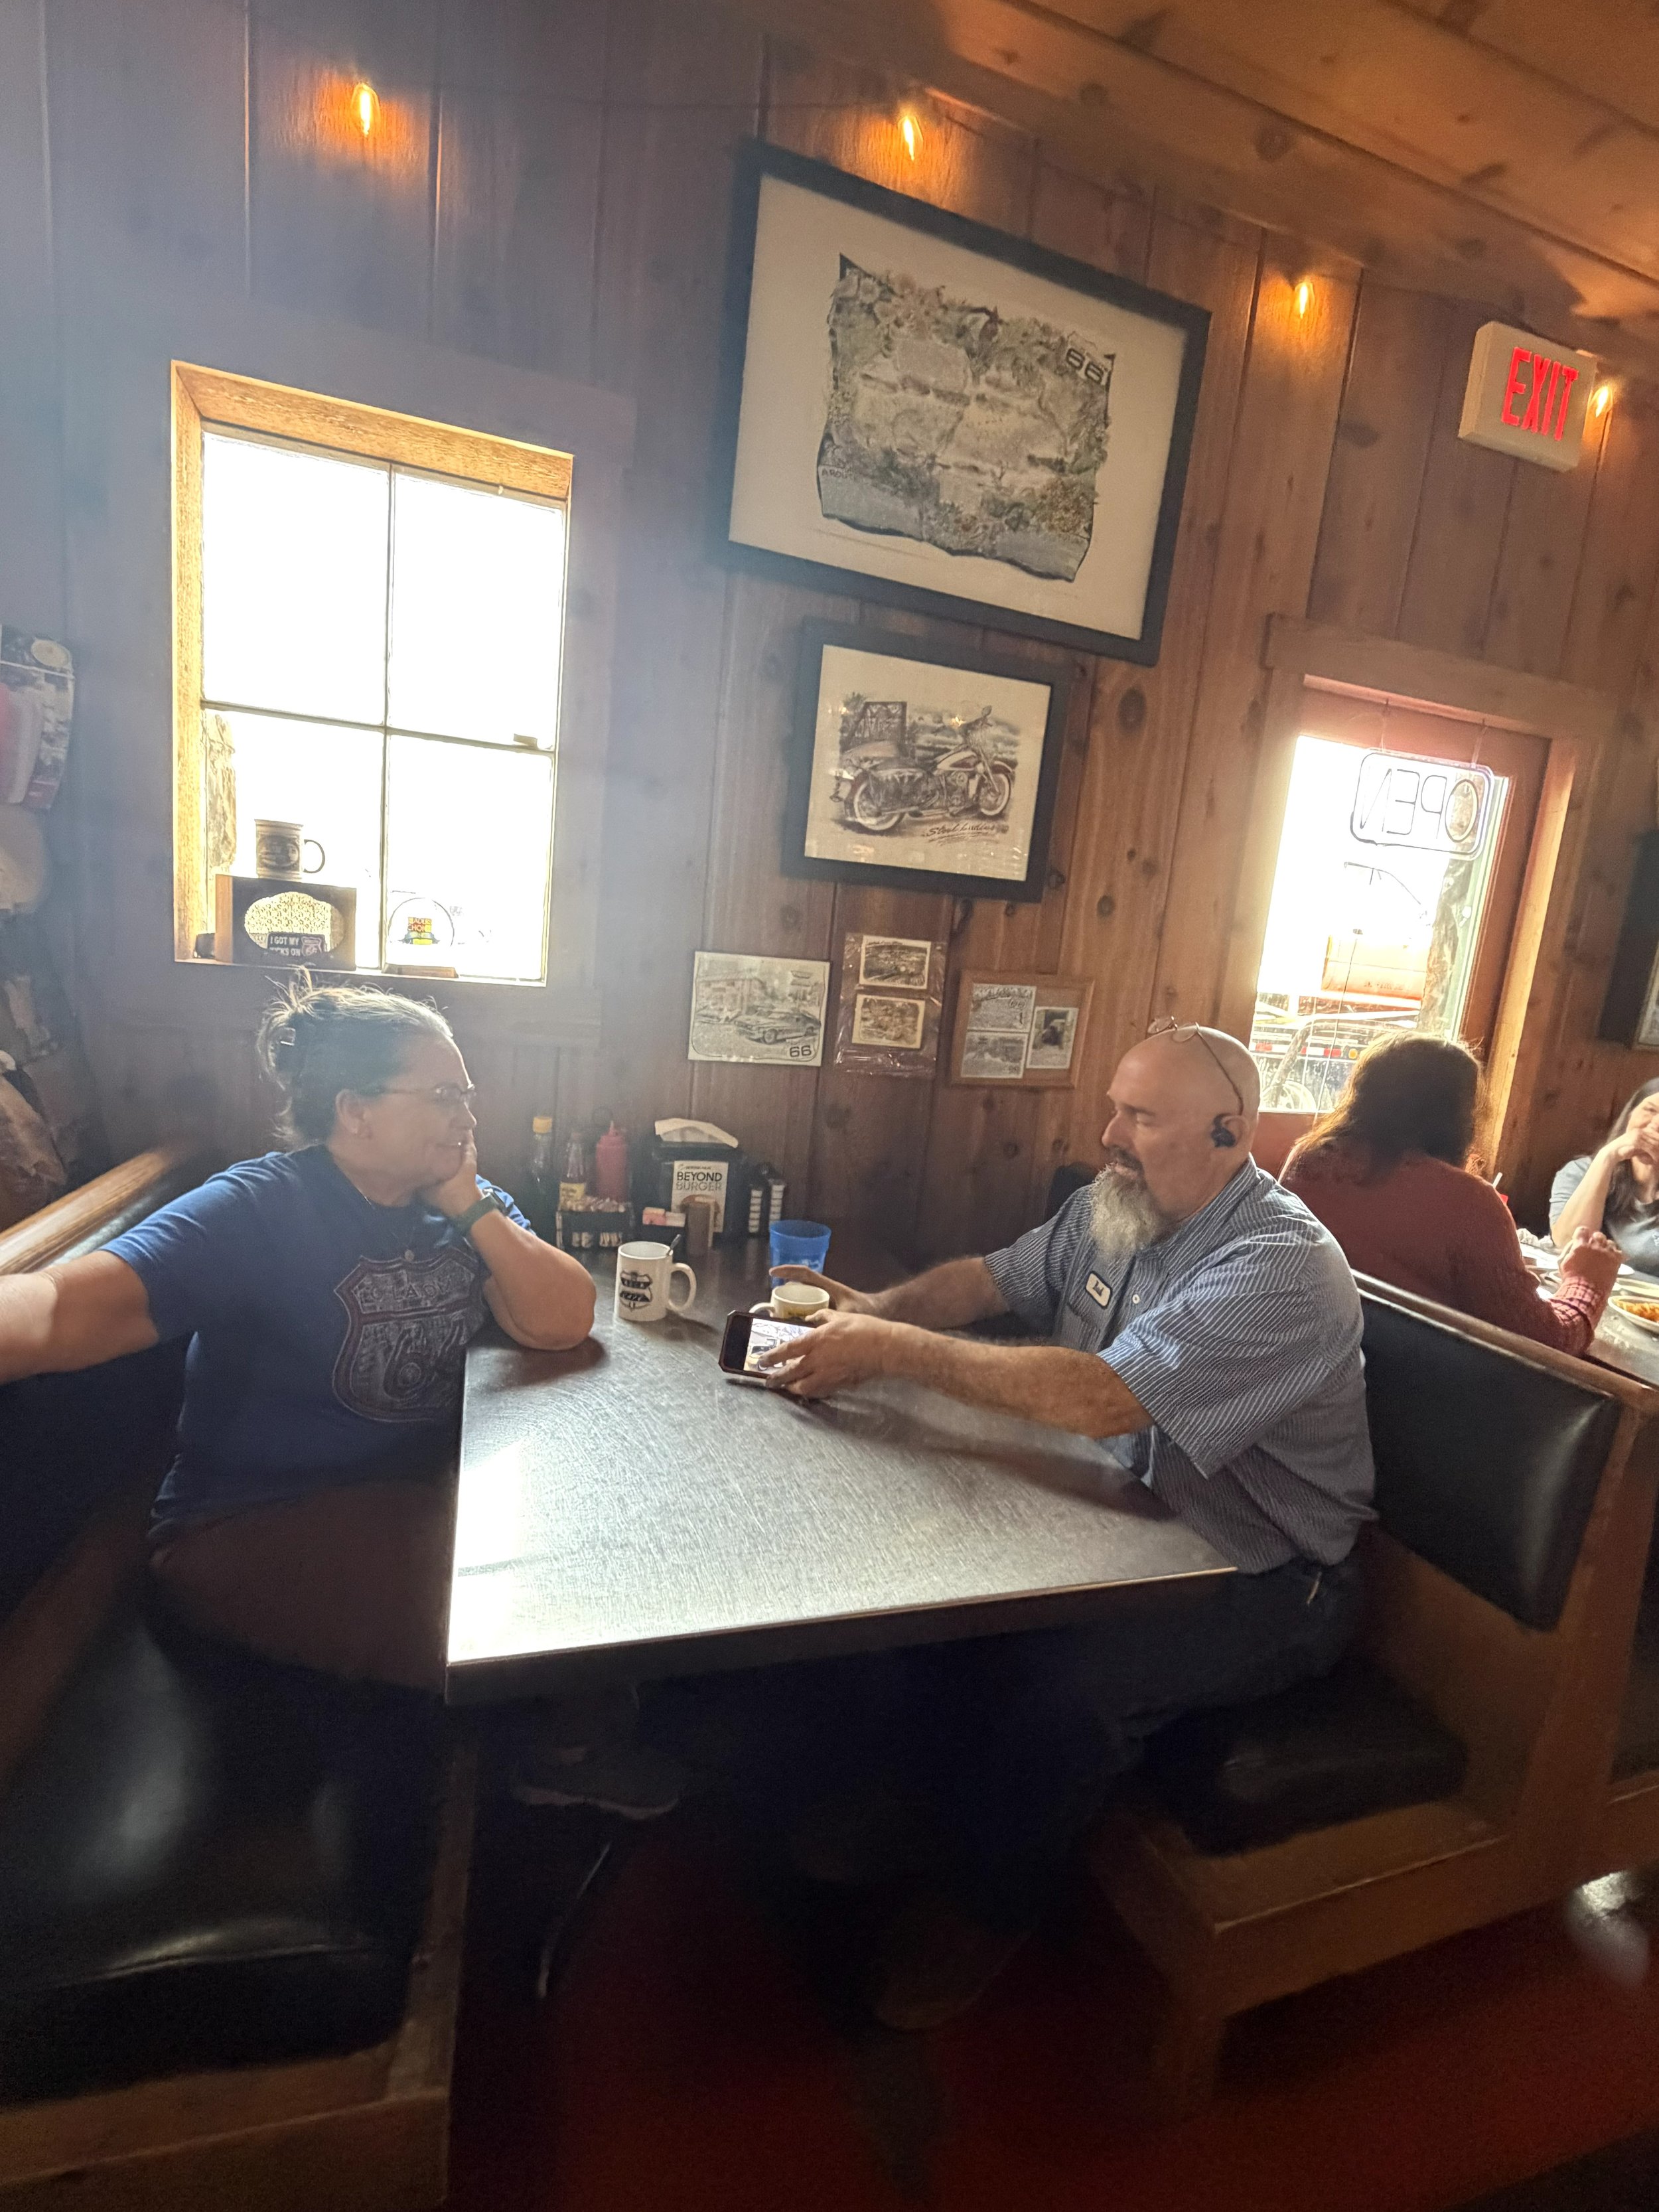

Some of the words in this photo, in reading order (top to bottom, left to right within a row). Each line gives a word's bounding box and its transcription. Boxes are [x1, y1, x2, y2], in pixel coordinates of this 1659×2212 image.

[1501, 346, 1579, 441] EXIT
[407, 924, 432, 932] CHOI
[274, 936, 287, 945] GOT
[289, 936, 300, 946] MY
[290, 948, 301, 956] ON
[789, 1045, 812, 1058] 66
[677, 1171, 723, 1182] BEYOND
[676, 1181, 722, 1192] BURGER
